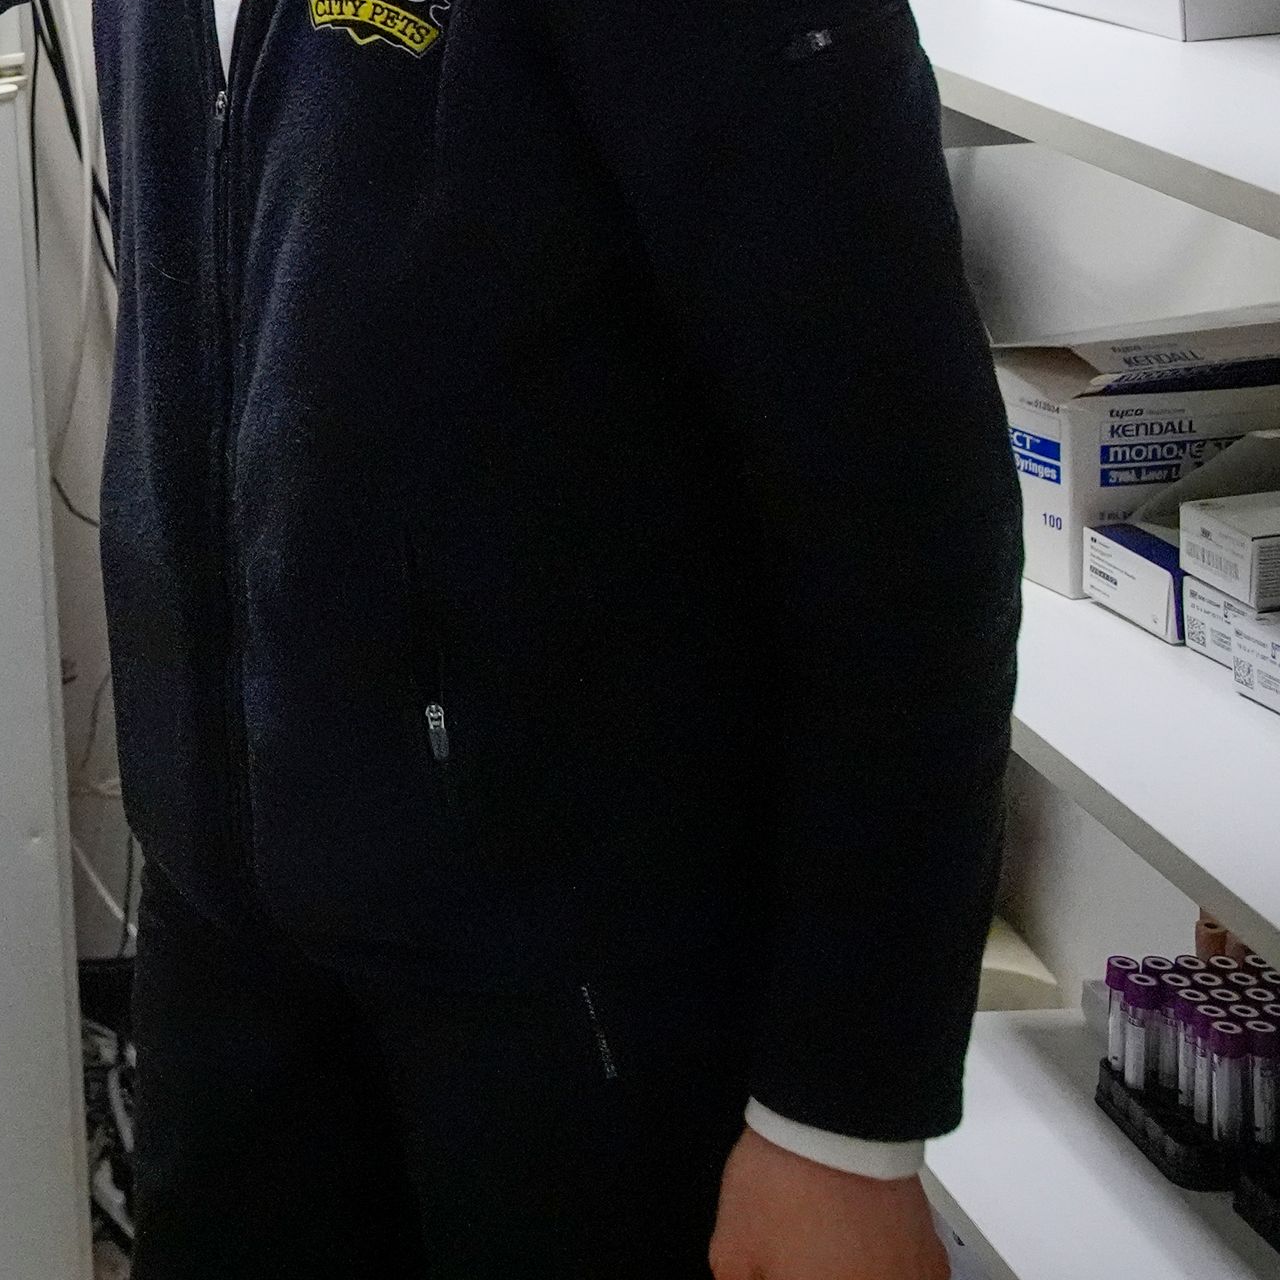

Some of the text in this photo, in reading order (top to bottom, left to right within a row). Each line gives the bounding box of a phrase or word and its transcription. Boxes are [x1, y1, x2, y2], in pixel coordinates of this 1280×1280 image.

[369, 2, 431, 45] PETS
[1123, 350, 1206, 368] KENDALL
[1109, 407, 1144, 419] tyco
[1109, 420, 1198, 439] KENDALL
[1042, 512, 1063, 531] 100
